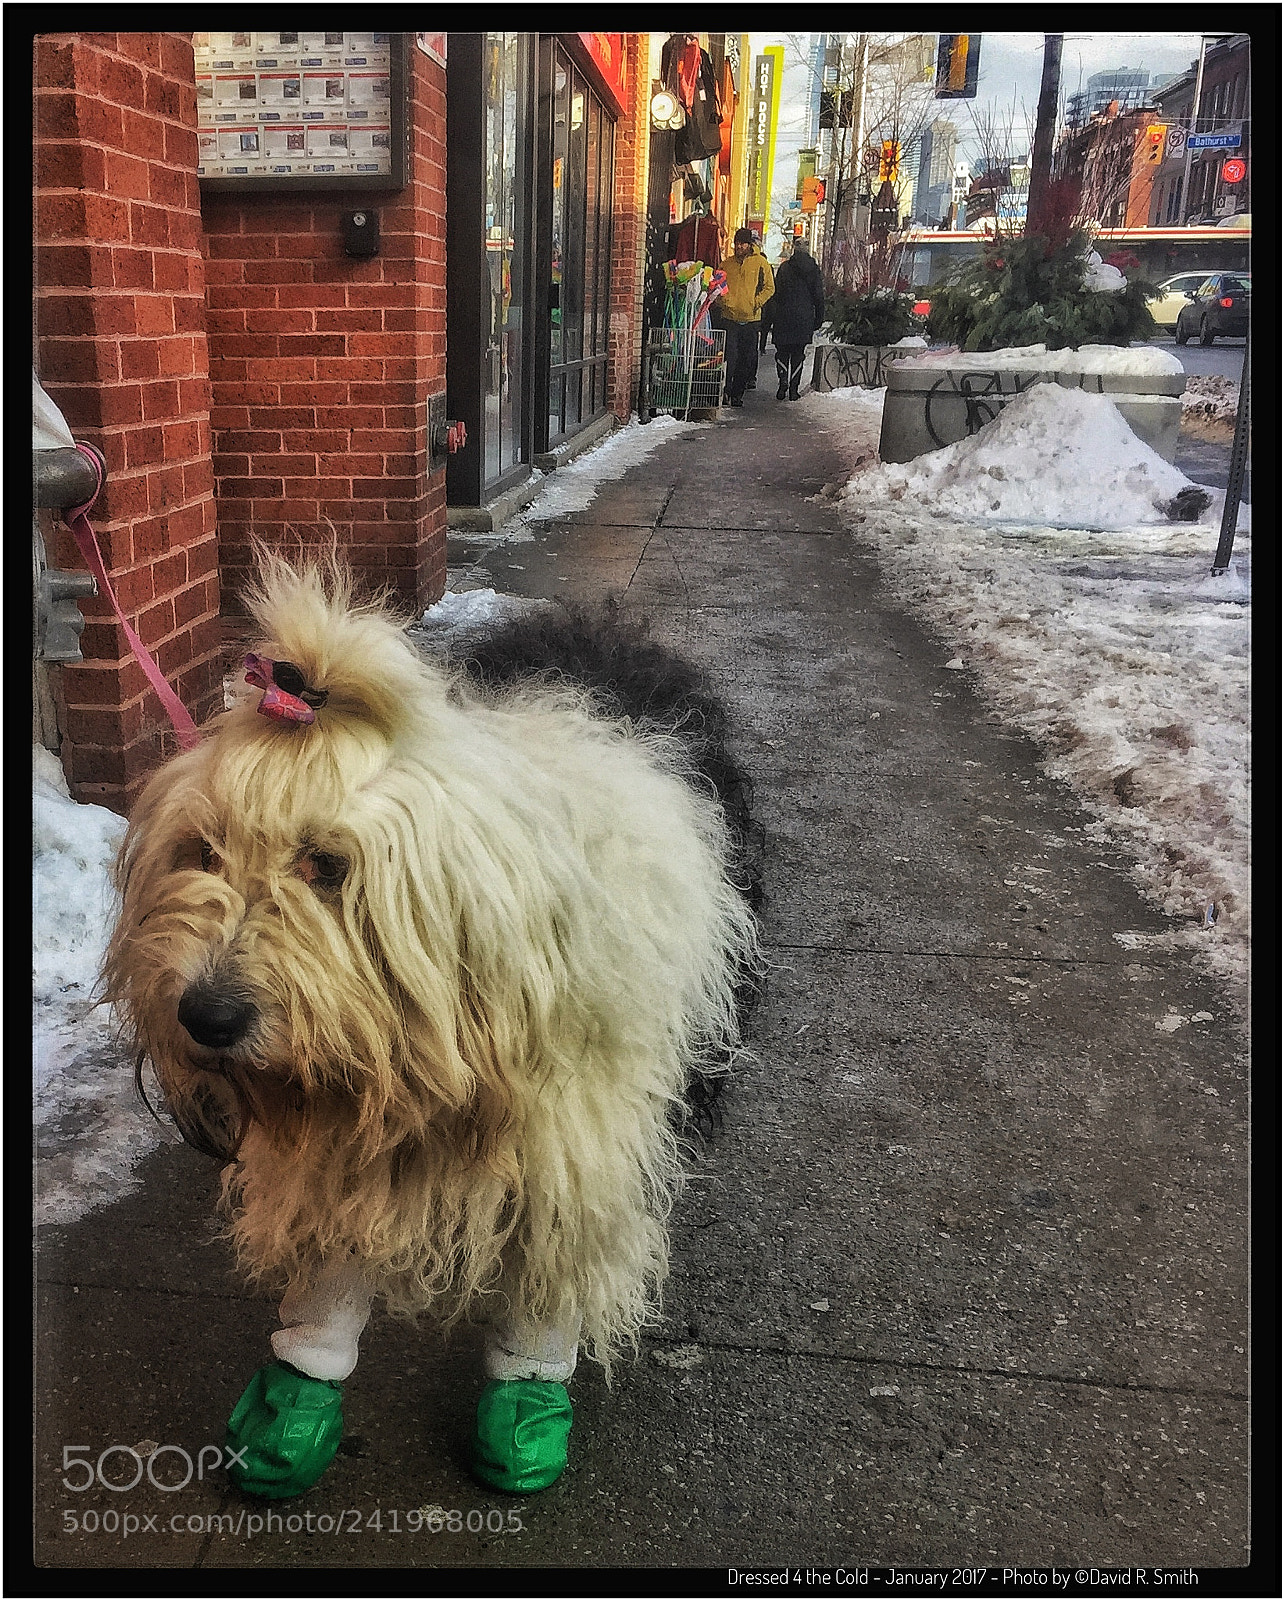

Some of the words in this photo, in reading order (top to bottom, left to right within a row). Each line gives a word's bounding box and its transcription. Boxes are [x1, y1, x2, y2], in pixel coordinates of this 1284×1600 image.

[760, 63, 770, 96] HOT
[757, 101, 767, 145] DOCS
[1195, 137, 1227, 146] Bathurst
